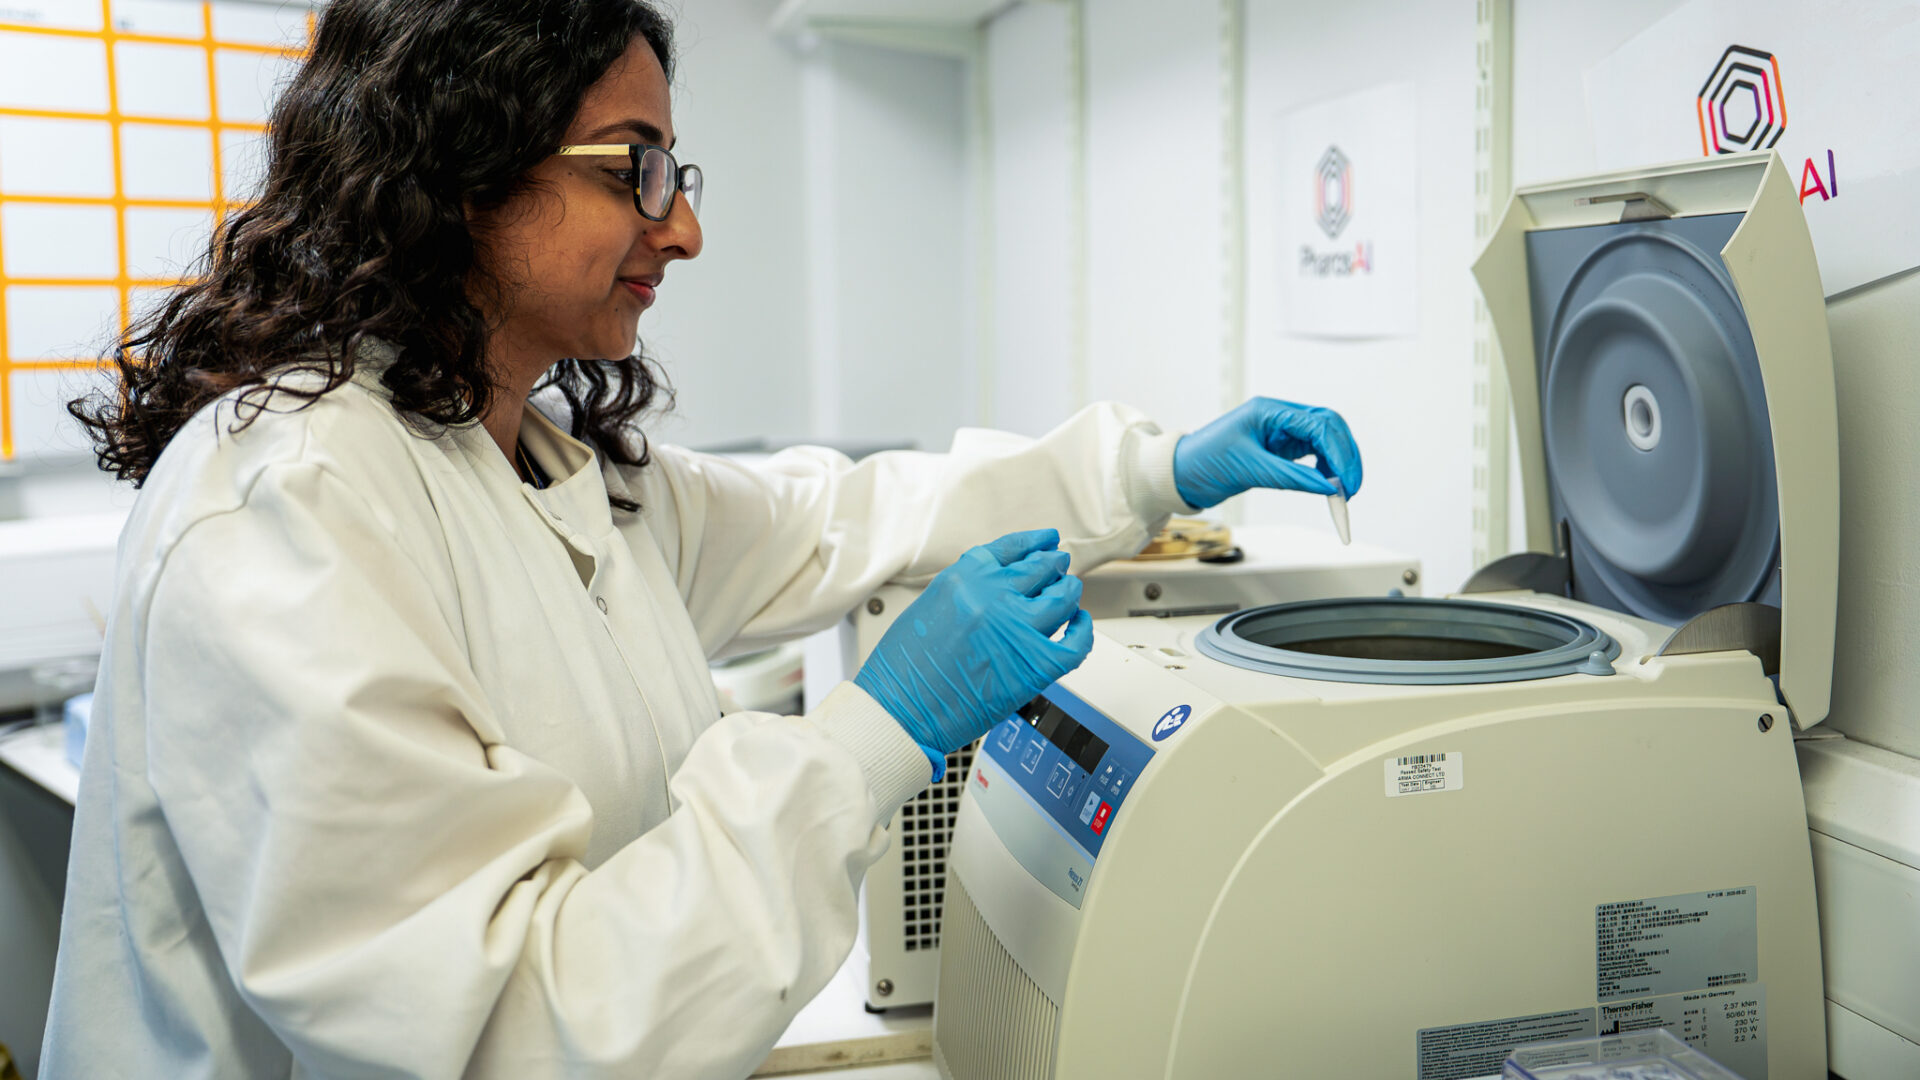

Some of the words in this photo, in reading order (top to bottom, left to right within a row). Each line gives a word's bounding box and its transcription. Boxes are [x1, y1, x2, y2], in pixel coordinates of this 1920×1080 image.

[1708, 990, 1735, 998] Germany
[1724, 1002, 1738, 1010] 2.37
[1603, 1008, 1653, 1020] SCIENTIFIC
[1726, 1011, 1745, 1019] 50/60
